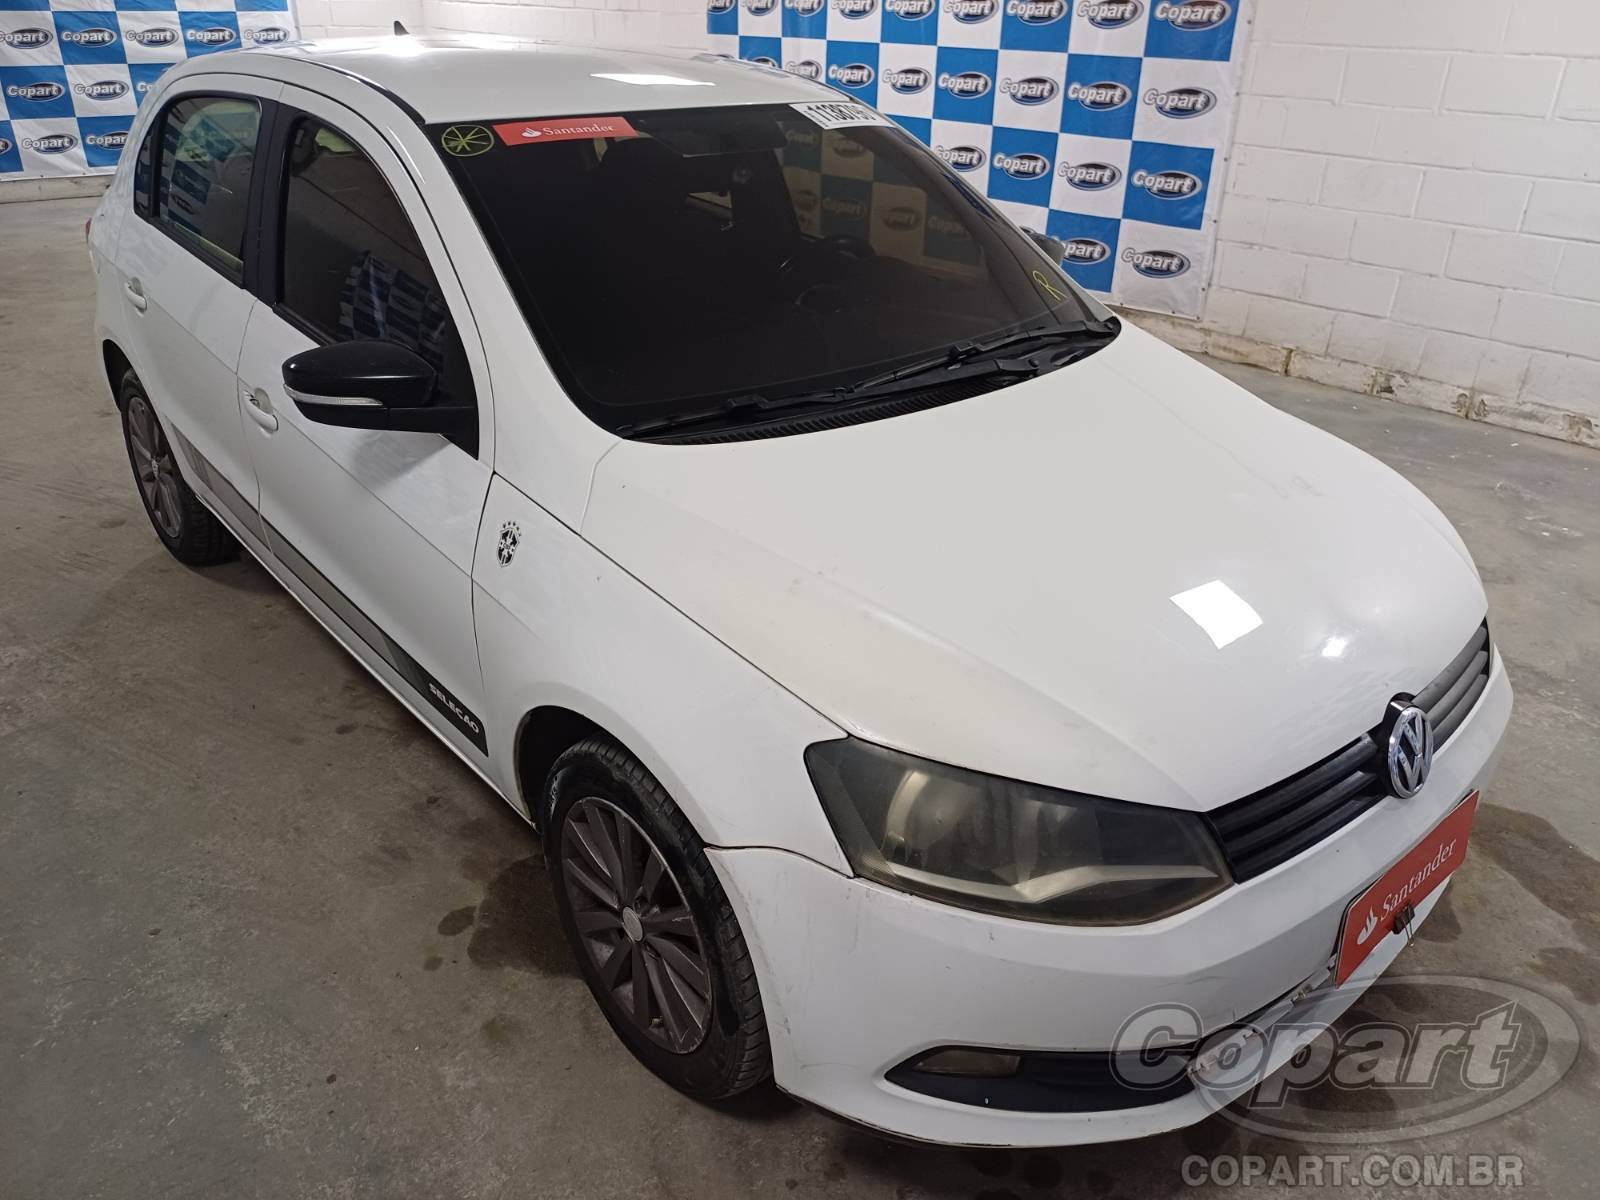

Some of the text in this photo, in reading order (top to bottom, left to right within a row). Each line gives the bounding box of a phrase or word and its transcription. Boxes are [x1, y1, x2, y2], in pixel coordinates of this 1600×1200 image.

[885, 0, 928, 14] Copart
[944, 0, 991, 18] Copart
[1006, 0, 1060, 20] Copart
[1077, 0, 1133, 22] Copart
[1156, 1, 1223, 24] Copart
[61, 31, 111, 45] Copart
[125, 30, 172, 45] Copart
[186, 29, 230, 44] Copart
[244, 30, 285, 43] Copart
[828, 64, 868, 83] Copart
[883, 69, 928, 88] Copart
[938, 73, 985, 93] Copart
[7, 85, 58, 99] Copart
[73, 83, 122, 97] Copart
[1000, 78, 1051, 99] Copart
[1068, 83, 1121, 104] Copart
[1144, 89, 1205, 112] Copart
[542, 124, 616, 136] Santander
[22, 138, 71, 151] Copart
[86, 135, 128, 148] Copar
[993, 153, 1043, 174] Copart
[1058, 161, 1113, 185] Copart
[1132, 171, 1193, 194] Copart
[1122, 247, 1182, 274] Copart
[1380, 838, 1457, 921] Santander
